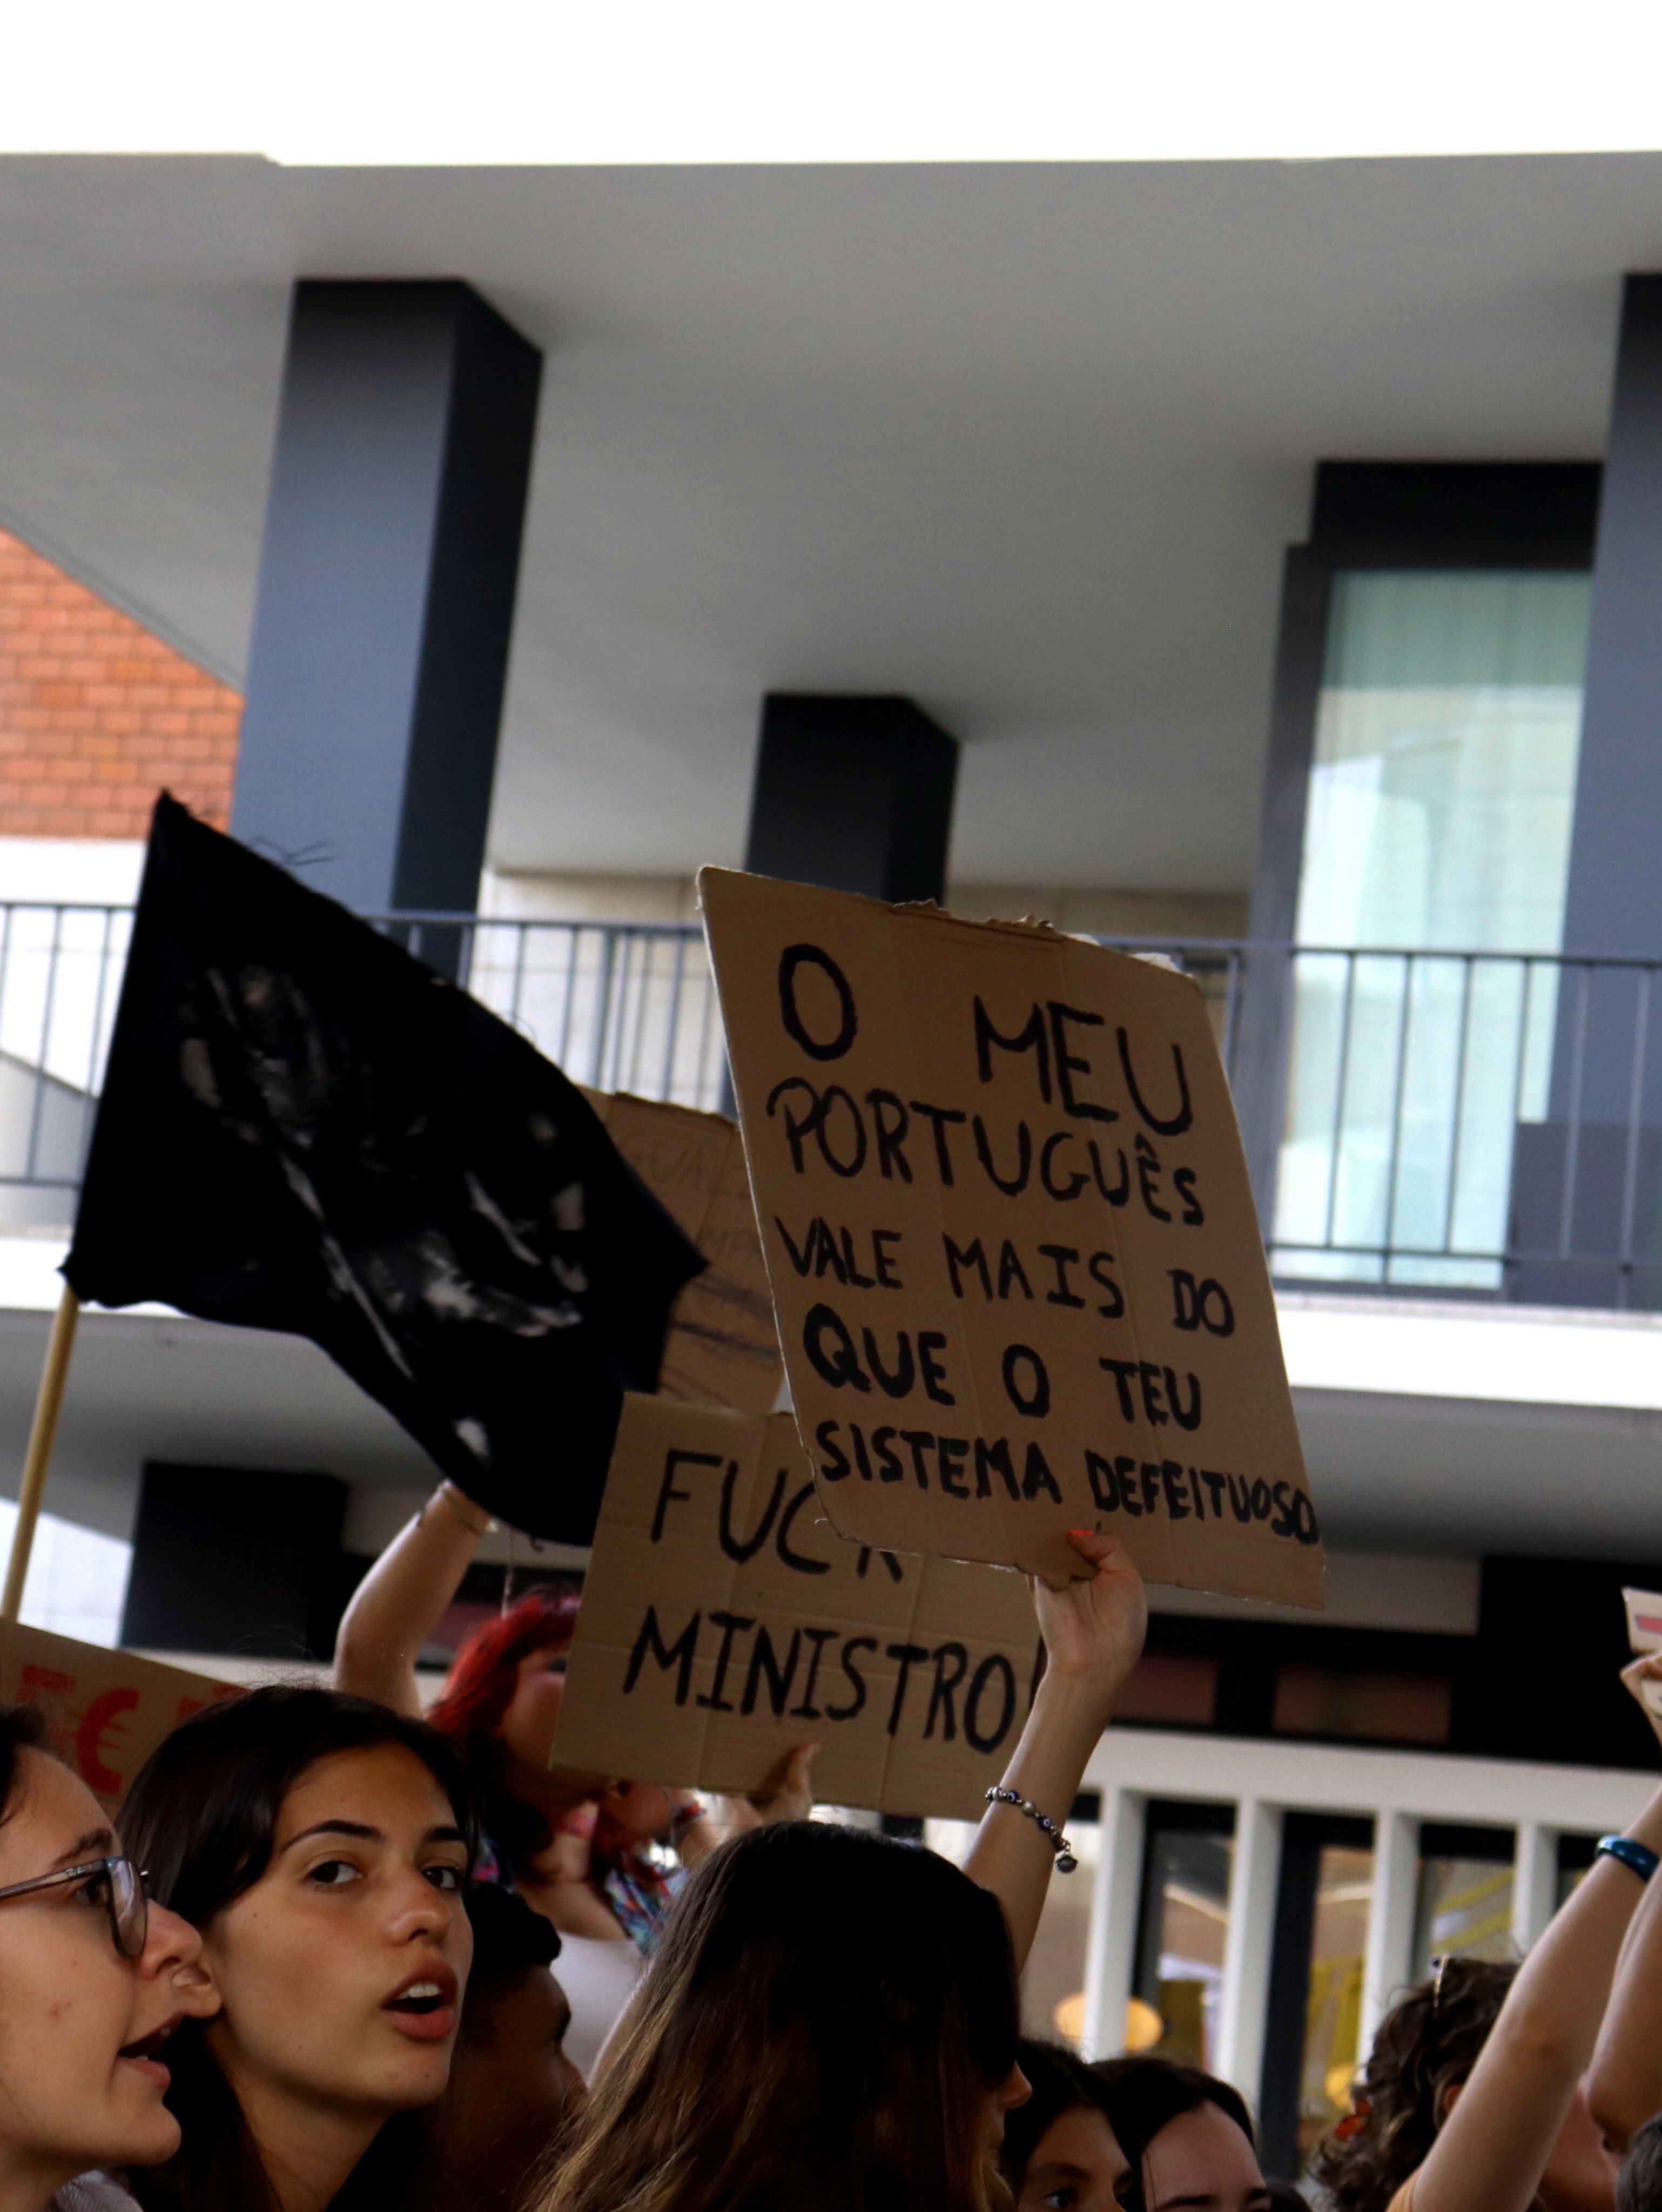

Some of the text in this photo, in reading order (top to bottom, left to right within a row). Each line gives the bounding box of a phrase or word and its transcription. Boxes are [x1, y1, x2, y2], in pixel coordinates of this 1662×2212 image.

[778, 943, 1193, 1136] O MEU
[766, 1077, 1204, 1225] PORTUGUÊS
[775, 1216, 904, 1289] VALE
[942, 1231, 1125, 1319] MAIS
[1167, 1268, 1235, 1337] DO
[803, 1303, 1201, 1431] QUE O TEU
[816, 1420, 1319, 1546] SISTEMA DEFEITUOSO
[623, 1606, 1016, 1755] MINISTRO
